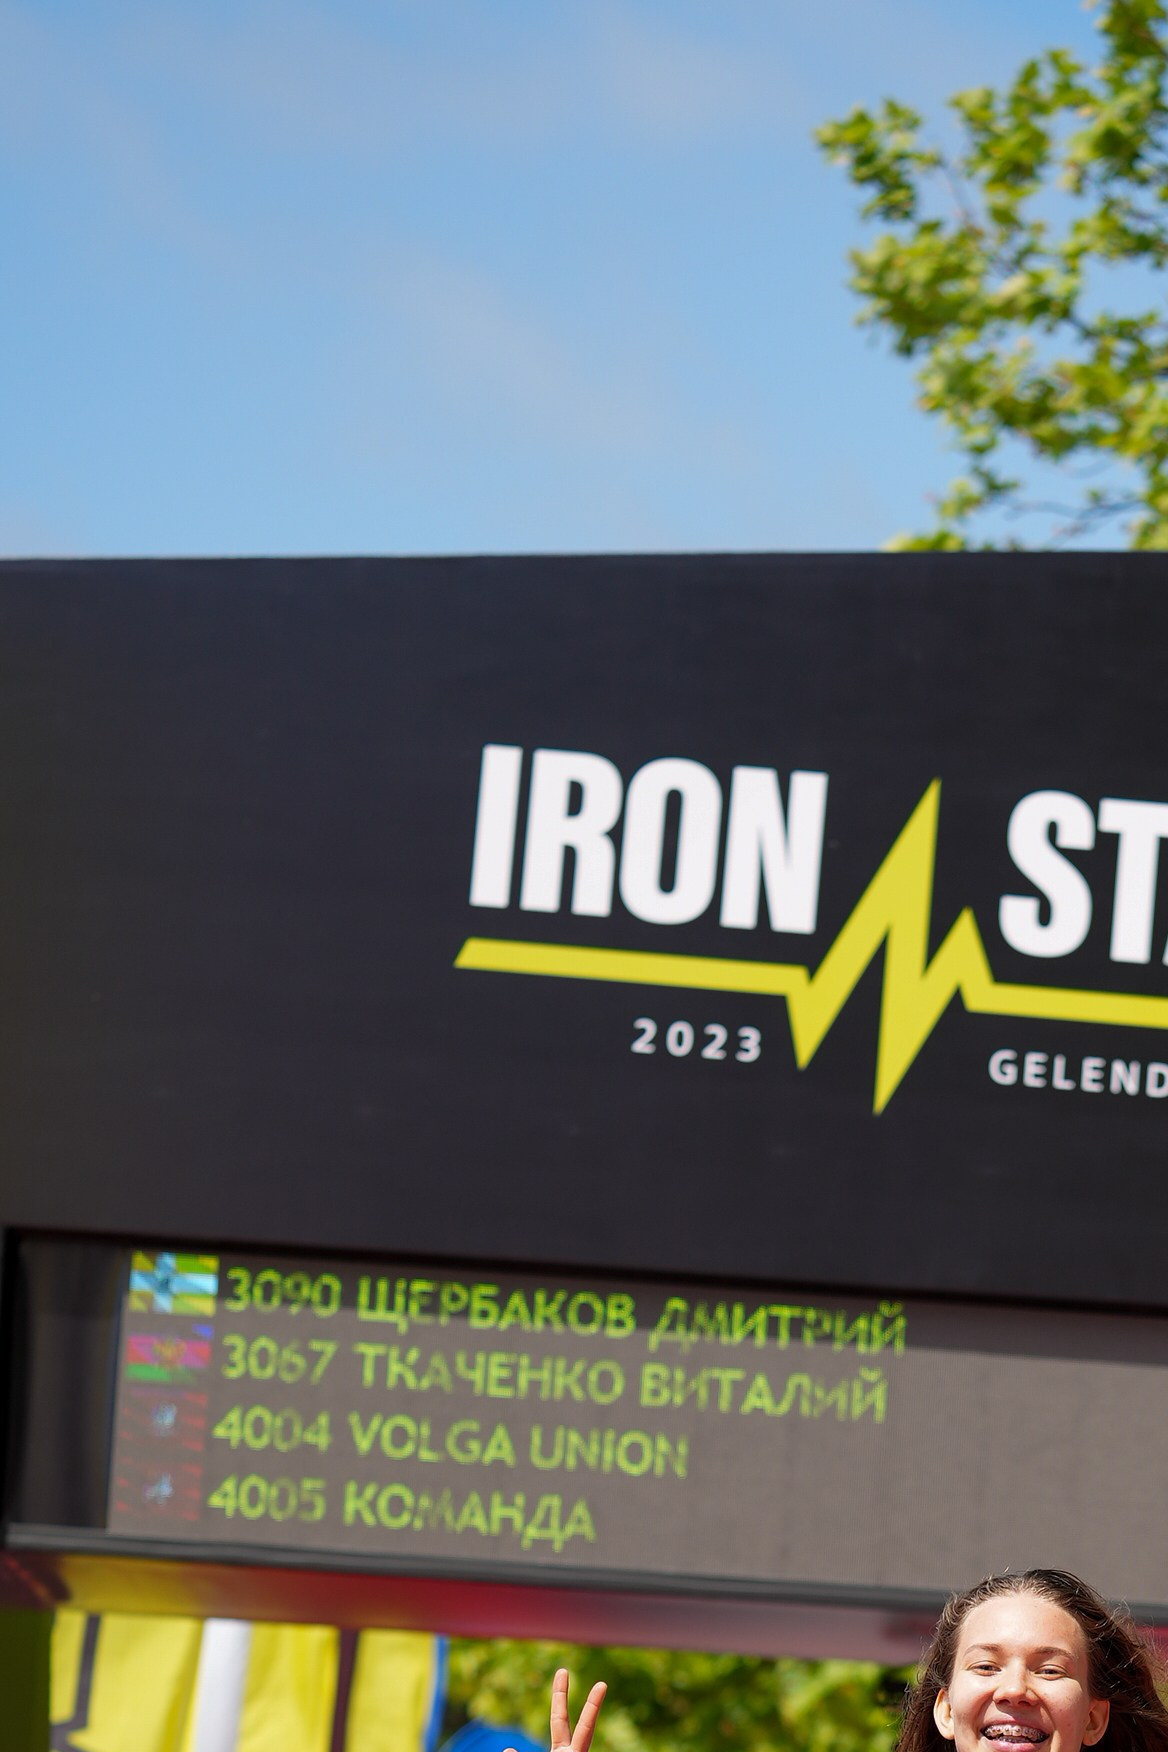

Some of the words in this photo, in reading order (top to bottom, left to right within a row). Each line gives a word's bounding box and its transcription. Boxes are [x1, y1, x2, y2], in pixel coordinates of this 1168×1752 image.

[468, 743, 829, 935] IRON
[630, 1018, 763, 1063] 2023
[225, 1268, 341, 1318] 3090
[358, 1276, 636, 1339] ЩЕРБАКОВ
[648, 1297, 907, 1356] ДМИТРИЙ
[221, 1335, 335, 1382] 3067
[353, 1342, 625, 1406] ТКАЧЕНКО
[640, 1366, 887, 1424] ВИТАЛИЙ
[212, 1405, 332, 1453] 4004
[349, 1412, 517, 1467] VOLGA
[530, 1426, 688, 1478] UNION
[208, 1473, 326, 1522] 4005
[343, 1480, 597, 1552] КОМАНДА
